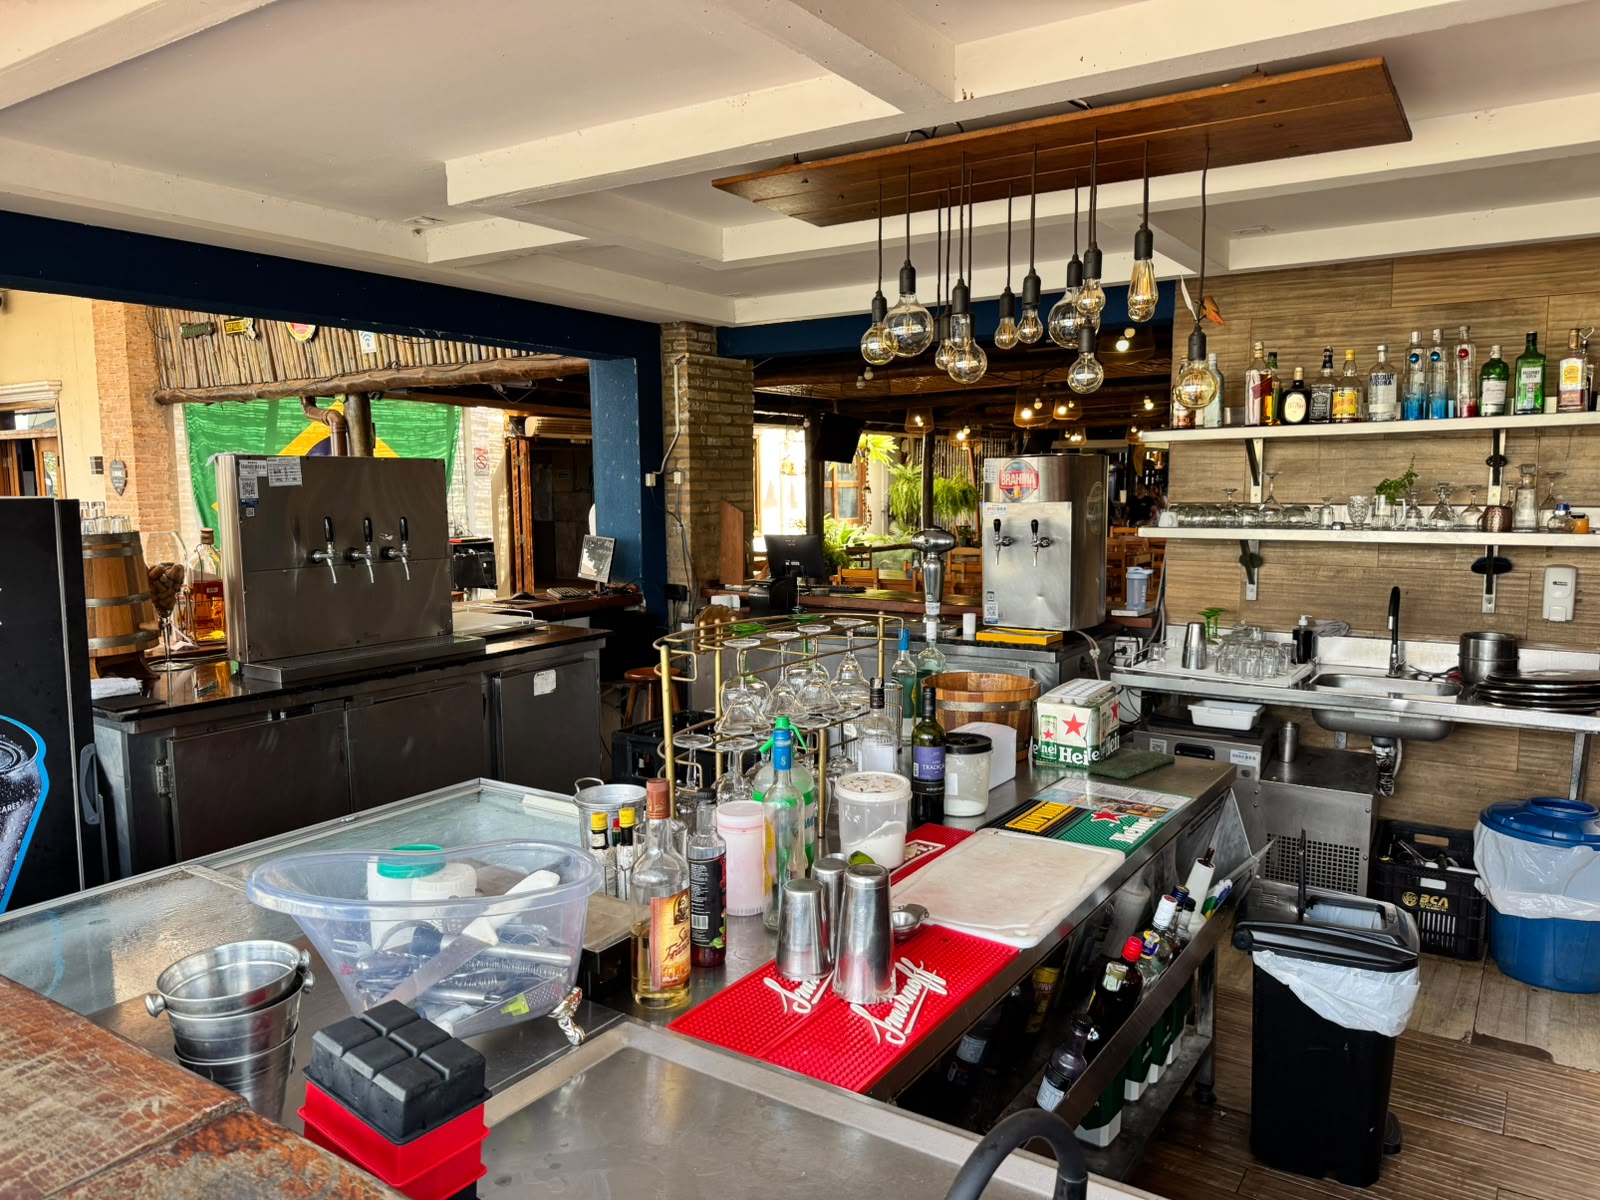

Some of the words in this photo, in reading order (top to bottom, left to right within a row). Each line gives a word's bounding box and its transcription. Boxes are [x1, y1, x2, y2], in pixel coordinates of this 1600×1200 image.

[1001, 472, 1037, 487] BRAHMA
[1421, 894, 1449, 907] BCA
[849, 956, 948, 1045] Smirnoff
